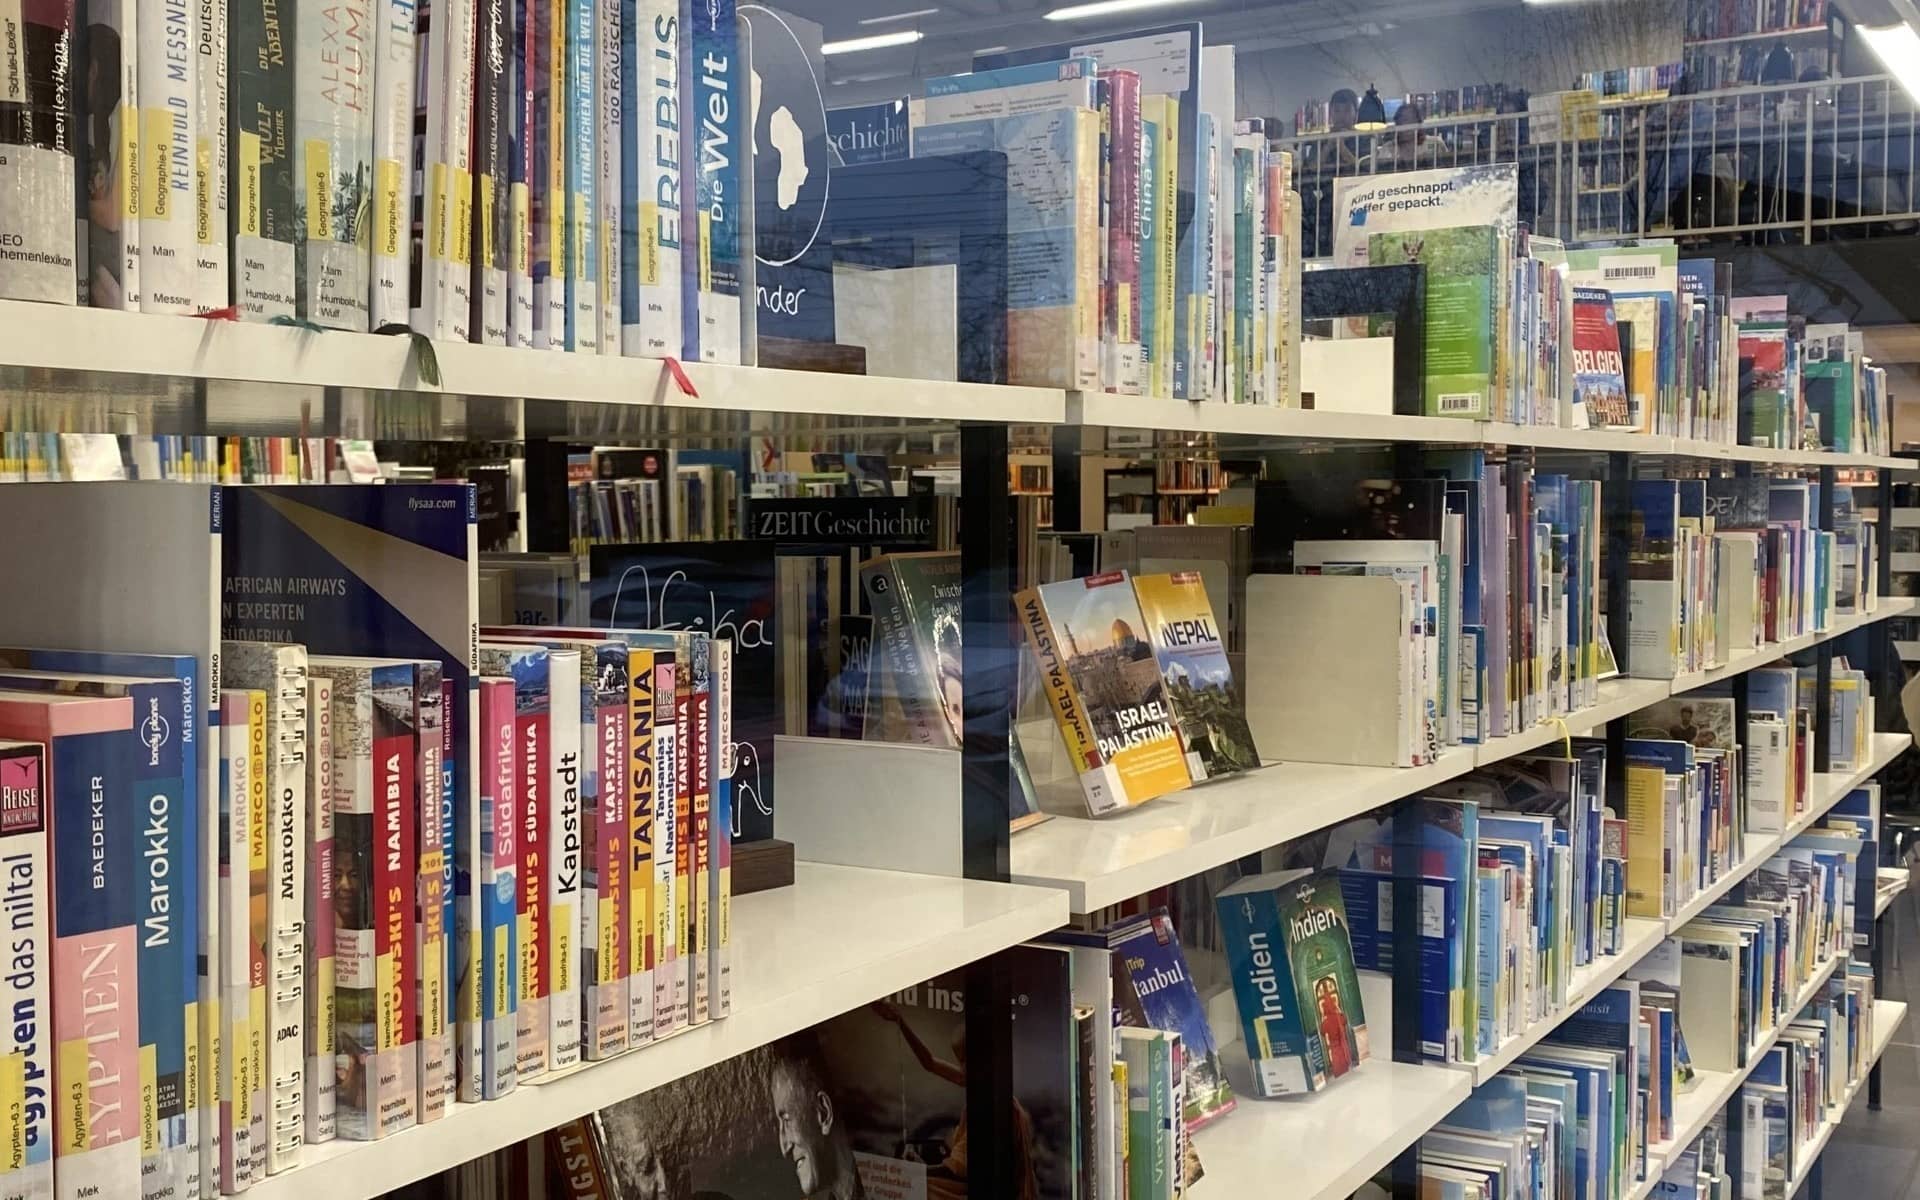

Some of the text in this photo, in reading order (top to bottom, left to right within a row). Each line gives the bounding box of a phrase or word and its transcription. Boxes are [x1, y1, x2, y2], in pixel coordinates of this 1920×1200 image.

[580, 3, 592, 40] WELT
[259, 47, 269, 70] DIE
[581, 45, 592, 68] DIE
[581, 73, 592, 94] UM
[258, 102, 273, 166] WULF
[610, 99, 619, 126] 100
[703, 51, 730, 223] Die Welt
[171, 97, 189, 191] REINHOLD
[218, 116, 227, 169] Suche
[129, 142, 137, 215] Geographie-6
[155, 144, 167, 216] Geographie-6
[198, 170, 208, 240] Geographie-6
[218, 174, 227, 210] Eine
[247, 166, 256, 232] Geographie-6
[318, 171, 327, 237] Geographie-6
[1140, 168, 1153, 241] China
[1351, 181, 1457, 206] Kind geschnappt.
[387, 190, 397, 254] Geographie-6
[1348, 196, 1444, 219] Koffer gepackt.
[152, 245, 175, 257] Man
[245, 272, 251, 281] 2
[246, 302, 264, 313] Wulf
[321, 278, 335, 288] 2.0
[380, 279, 394, 288] Mb
[320, 308, 340, 318] Wulf
[1573, 349, 1624, 377] BELGIEN
[212, 491, 221, 528] MERIAN
[408, 497, 456, 510] flysaa.com
[469, 486, 477, 519] MERIAN
[225, 577, 346, 596] AFRICAN AIRWAYS
[238, 603, 305, 621] EXPERTEN
[471, 622, 479, 671] SÜDAFRIKA
[1162, 618, 1218, 648] NEPAL
[211, 653, 219, 704] MAROKKO
[182, 675, 194, 744] Marokko
[443, 694, 452, 751] Reisekarte
[721, 651, 730, 770] MARCO POLO
[1115, 701, 1169, 730] ISRAEL
[320, 687, 332, 830] MARCO POLO
[605, 714, 617, 824] KAPSTADT
[678, 701, 689, 794] TANSANIA
[698, 698, 709, 790] TANSANIA
[1098, 722, 1176, 759] PALÄSTINA
[3, 785, 38, 810] REISE
[253, 701, 264, 857] MARCO POLO
[424, 747, 435, 818] NAMIBIA
[498, 723, 514, 858] Südafrika
[526, 722, 538, 844] SÜDAFRIKA
[633, 666, 653, 873] TANSANIA
[655, 736, 666, 822] Tansanias
[665, 734, 675, 856] Nationalparks
[235, 756, 248, 845] MAROKKO
[387, 751, 401, 872] NAMIBIA
[557, 751, 581, 895] Kapstadt
[91, 775, 105, 890] BAEDEKER
[280, 787, 295, 900] Marokko
[425, 823, 435, 847] 101
[2, 852, 35, 932] niltal
[143, 793, 171, 949] Marokko
[321, 847, 332, 900] NAMIBIA
[603, 926, 611, 982] Südafrika-6.3
[1290, 908, 1338, 946] Indien
[5, 937, 36, 991] das
[521, 942, 529, 1000] Südafrika-6.3
[560, 935, 568, 992] Südafrika-6.3
[1249, 931, 1286, 1021] Indien
[276, 1024, 299, 1043] ADAC
[326, 995, 335, 1053] Namibia-6.3
[384, 991, 392, 1048] Namibia-6.3
[431, 980, 439, 1036] Namibia-6.3
[556, 1019, 574, 1029] Mem
[188, 1044, 197, 1109] Marokko-6.3
[240, 1056, 248, 1120] Marokko-6.3
[253, 1030, 261, 1092] Marokko-6.3
[380, 1073, 397, 1087] Mem
[425, 1060, 443, 1072] Mem
[556, 1055, 577, 1065] Vartan
[72, 1082, 87, 1149] Ägypten-6.3
[143, 1084, 152, 1151] Marokko-6.3
[380, 1098, 407, 1113] Namibia
[380, 1108, 414, 1127] Iwanowski
[10, 1102, 22, 1170] Ägypten-6.3
[77, 1184, 100, 1199] Mek
